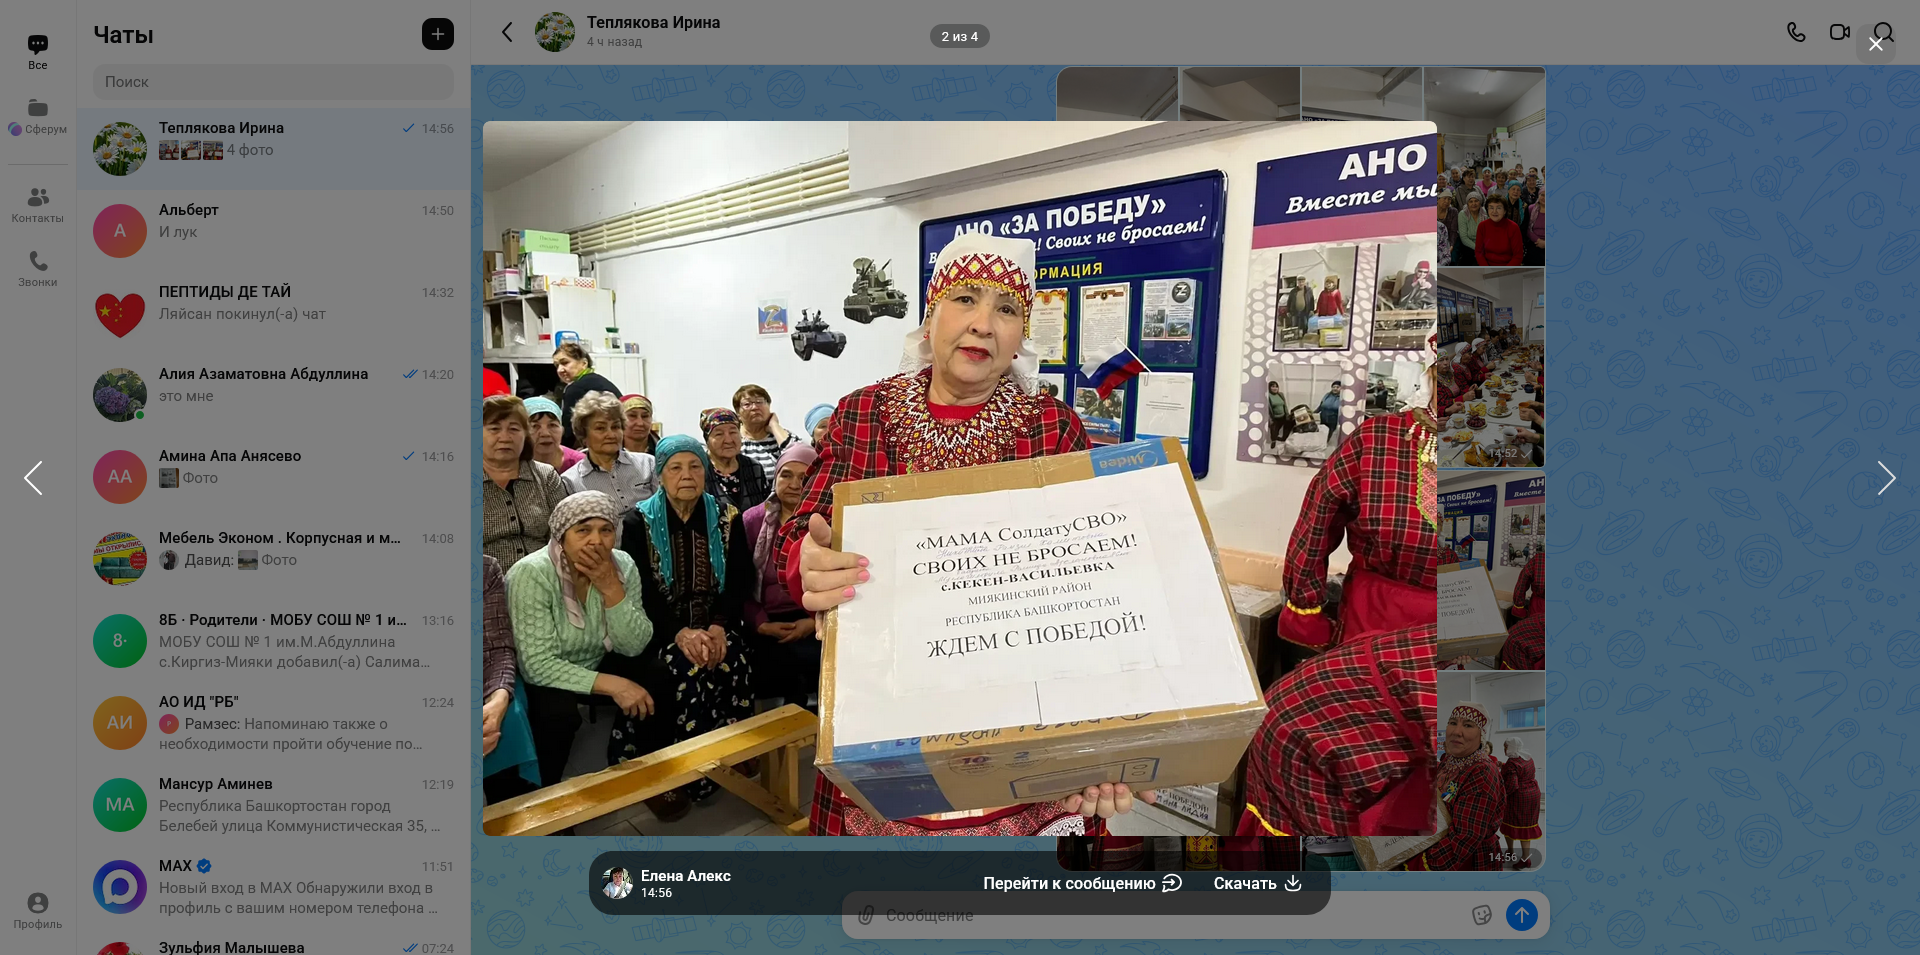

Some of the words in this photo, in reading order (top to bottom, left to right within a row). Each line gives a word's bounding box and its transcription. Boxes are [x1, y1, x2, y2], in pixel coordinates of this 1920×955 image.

[587, 16, 668, 28] Теплякова
[673, 16, 720, 31] Ирина
[94, 26, 152, 43] Чаты
[952, 33, 967, 41] из
[597, 38, 603, 46] ч
[607, 38, 642, 48] назад
[28, 60, 47, 69] Все
[105, 75, 149, 87] Поиск
[25, 123, 66, 135] Сферум
[159, 121, 235, 133] Теплякова
[239, 122, 284, 136] Ирина
[422, 123, 454, 133] 14:56
[226, 143, 235, 155] 4
[238, 143, 273, 158] фото
[1338, 143, 1428, 181] АНО
[1285, 188, 1386, 215] Вместе
[159, 203, 219, 218] Альберт
[422, 205, 453, 215] 14:50
[1000, 213, 1039, 235] «ЗА
[1046, 194, 1167, 230] ПОБЕДУ»
[11, 213, 63, 222] Контакты
[113, 224, 126, 237] А
[159, 225, 169, 237] И
[173, 228, 197, 240] лук
[1046, 233, 1092, 250] Своих
[1096, 230, 1116, 244] не
[1121, 215, 1207, 244] бросаем!
[1034, 262, 1103, 280] РМАЦИЯ
[18, 277, 57, 286] Звонки
[160, 286, 233, 300] ПЕПТИДЫ
[237, 286, 257, 300] ДЕ
[261, 283, 290, 297] ТАЙ
[422, 287, 454, 297] 14:32
[158, 307, 211, 319] Ляйсан
[217, 307, 297, 322] покинул(-а)
[302, 310, 326, 319] чат
[158, 367, 194, 379] Алия
[199, 367, 286, 379] Азаматовна
[290, 367, 368, 382] Абдуллина
[422, 369, 453, 379] 14:20
[159, 392, 182, 401] это
[186, 392, 213, 401] мне
[158, 449, 205, 461] Амина
[209, 449, 236, 461] Апа
[241, 449, 301, 461] Анясево
[422, 451, 454, 461] 14:16
[1488, 448, 1518, 458] 14:52
[107, 470, 132, 483] АА
[182, 471, 218, 483] Фото
[1446, 490, 1481, 502] ПОБЕДУ»
[916, 531, 993, 551] «МАМА
[998, 511, 1127, 542] СолдатуСВО»
[159, 531, 214, 543] Мебель
[218, 531, 273, 543] Эконом
[287, 532, 361, 546] Корпусная
[366, 534, 374, 543] и
[422, 533, 453, 543] 14:08
[105, 540, 143, 552] ОТКРЫЛИС
[184, 554, 233, 568] Давид:
[261, 553, 297, 565] Фото
[913, 555, 987, 576] СВОИХ
[993, 551, 1022, 567] НЕ
[1028, 533, 1138, 563] БРОСАЕМ!
[941, 561, 1115, 592] с.КЕКЕН-ВАСИЛЬЕВКА
[968, 586, 1050, 606] МИЯКИНСКИЙ
[1052, 581, 1092, 595] РАЙОН
[945, 608, 1021, 627] РЕСПУБЛИКА
[1023, 596, 1121, 617] БАШКОРТОСТАН
[159, 613, 177, 625] 8Б
[190, 614, 257, 627] Родители
[270, 613, 312, 625] МОБУ
[316, 613, 351, 625] СОШ
[375, 613, 381, 625] 1
[422, 615, 454, 625] 13:16
[927, 633, 998, 658] ЖДЕМ
[1004, 630, 1020, 648] С
[1026, 611, 1147, 645] ПОБЕДОЙ!
[159, 635, 201, 647] МОБУ
[205, 635, 239, 647] СОШ
[264, 635, 269, 647] 1
[277, 635, 395, 650] им.М.Абдуллина
[160, 656, 272, 670] с.Киргиз-Мияки
[277, 655, 360, 670] добавил(-а)
[158, 695, 179, 707] АО
[183, 696, 205, 710] ИД
[209, 695, 238, 707] "РБ"
[422, 697, 454, 707] 12:24
[106, 716, 132, 729] АИ
[185, 717, 240, 729] Рамзес:
[245, 717, 328, 729] Напоминаю
[332, 720, 375, 729] также
[379, 720, 387, 729] о
[160, 737, 268, 751] необходимости
[273, 738, 322, 752] пройти
[327, 737, 391, 752] обучение
[159, 778, 213, 792] Мансур
[216, 777, 272, 789] Аминев
[422, 779, 453, 789] 12:19
[106, 798, 134, 811] МА
[160, 799, 241, 814] Республика
[247, 800, 346, 814] Башкортостан
[351, 802, 390, 814] город
[159, 819, 217, 831] Белебей
[221, 822, 262, 834] улица
[268, 820, 402, 834] Коммунистическая
[407, 820, 426, 833] 35,
[1488, 852, 1518, 862] 14:56
[159, 859, 192, 871] MAX
[422, 861, 452, 871] 11:51
[641, 869, 683, 881] Елена
[686, 869, 731, 881] Алекс
[159, 881, 206, 893] Новый
[211, 884, 243, 895] вход
[248, 884, 255, 893] в
[260, 881, 292, 893] MAX
[297, 881, 383, 896] Обнаружили
[388, 884, 420, 895] вход
[425, 884, 432, 893] в
[984, 877, 1048, 892] Перейти
[1052, 879, 1061, 889] к
[1066, 877, 1156, 892] сообщению
[1214, 877, 1277, 889] Скачать
[641, 887, 672, 897] 14:56
[160, 901, 220, 916] профиль
[224, 904, 232, 913] с
[236, 904, 284, 913] вашим
[290, 904, 352, 916] номером
[357, 901, 423, 916] телефона
[886, 908, 974, 924] Сообщение
[13, 918, 62, 930] Профиль
[159, 941, 220, 955] Зульфия
[226, 941, 304, 953] Малышева
[421, 943, 454, 953] 07:24
